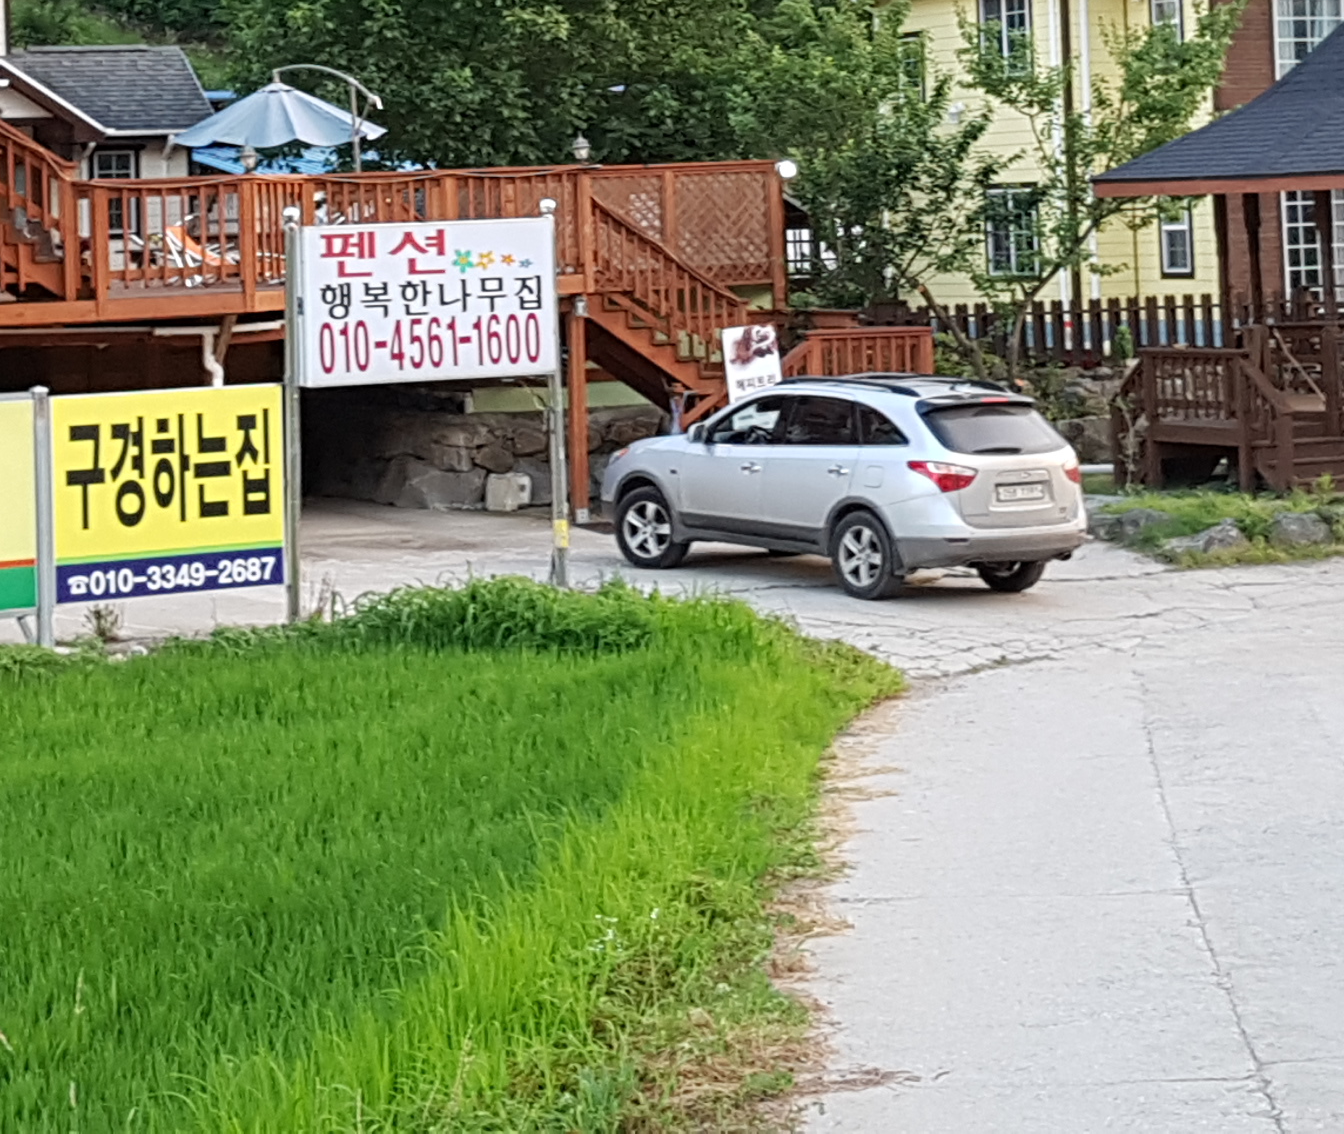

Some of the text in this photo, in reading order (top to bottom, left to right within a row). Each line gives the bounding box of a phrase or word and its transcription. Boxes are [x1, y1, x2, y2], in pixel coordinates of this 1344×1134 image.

[320, 229, 446, 278] 펜션
[320, 313, 540, 374] 010-4561-1600
[65, 408, 271, 530] 구경하는집
[89, 556, 276, 596] 010-3349-2687
